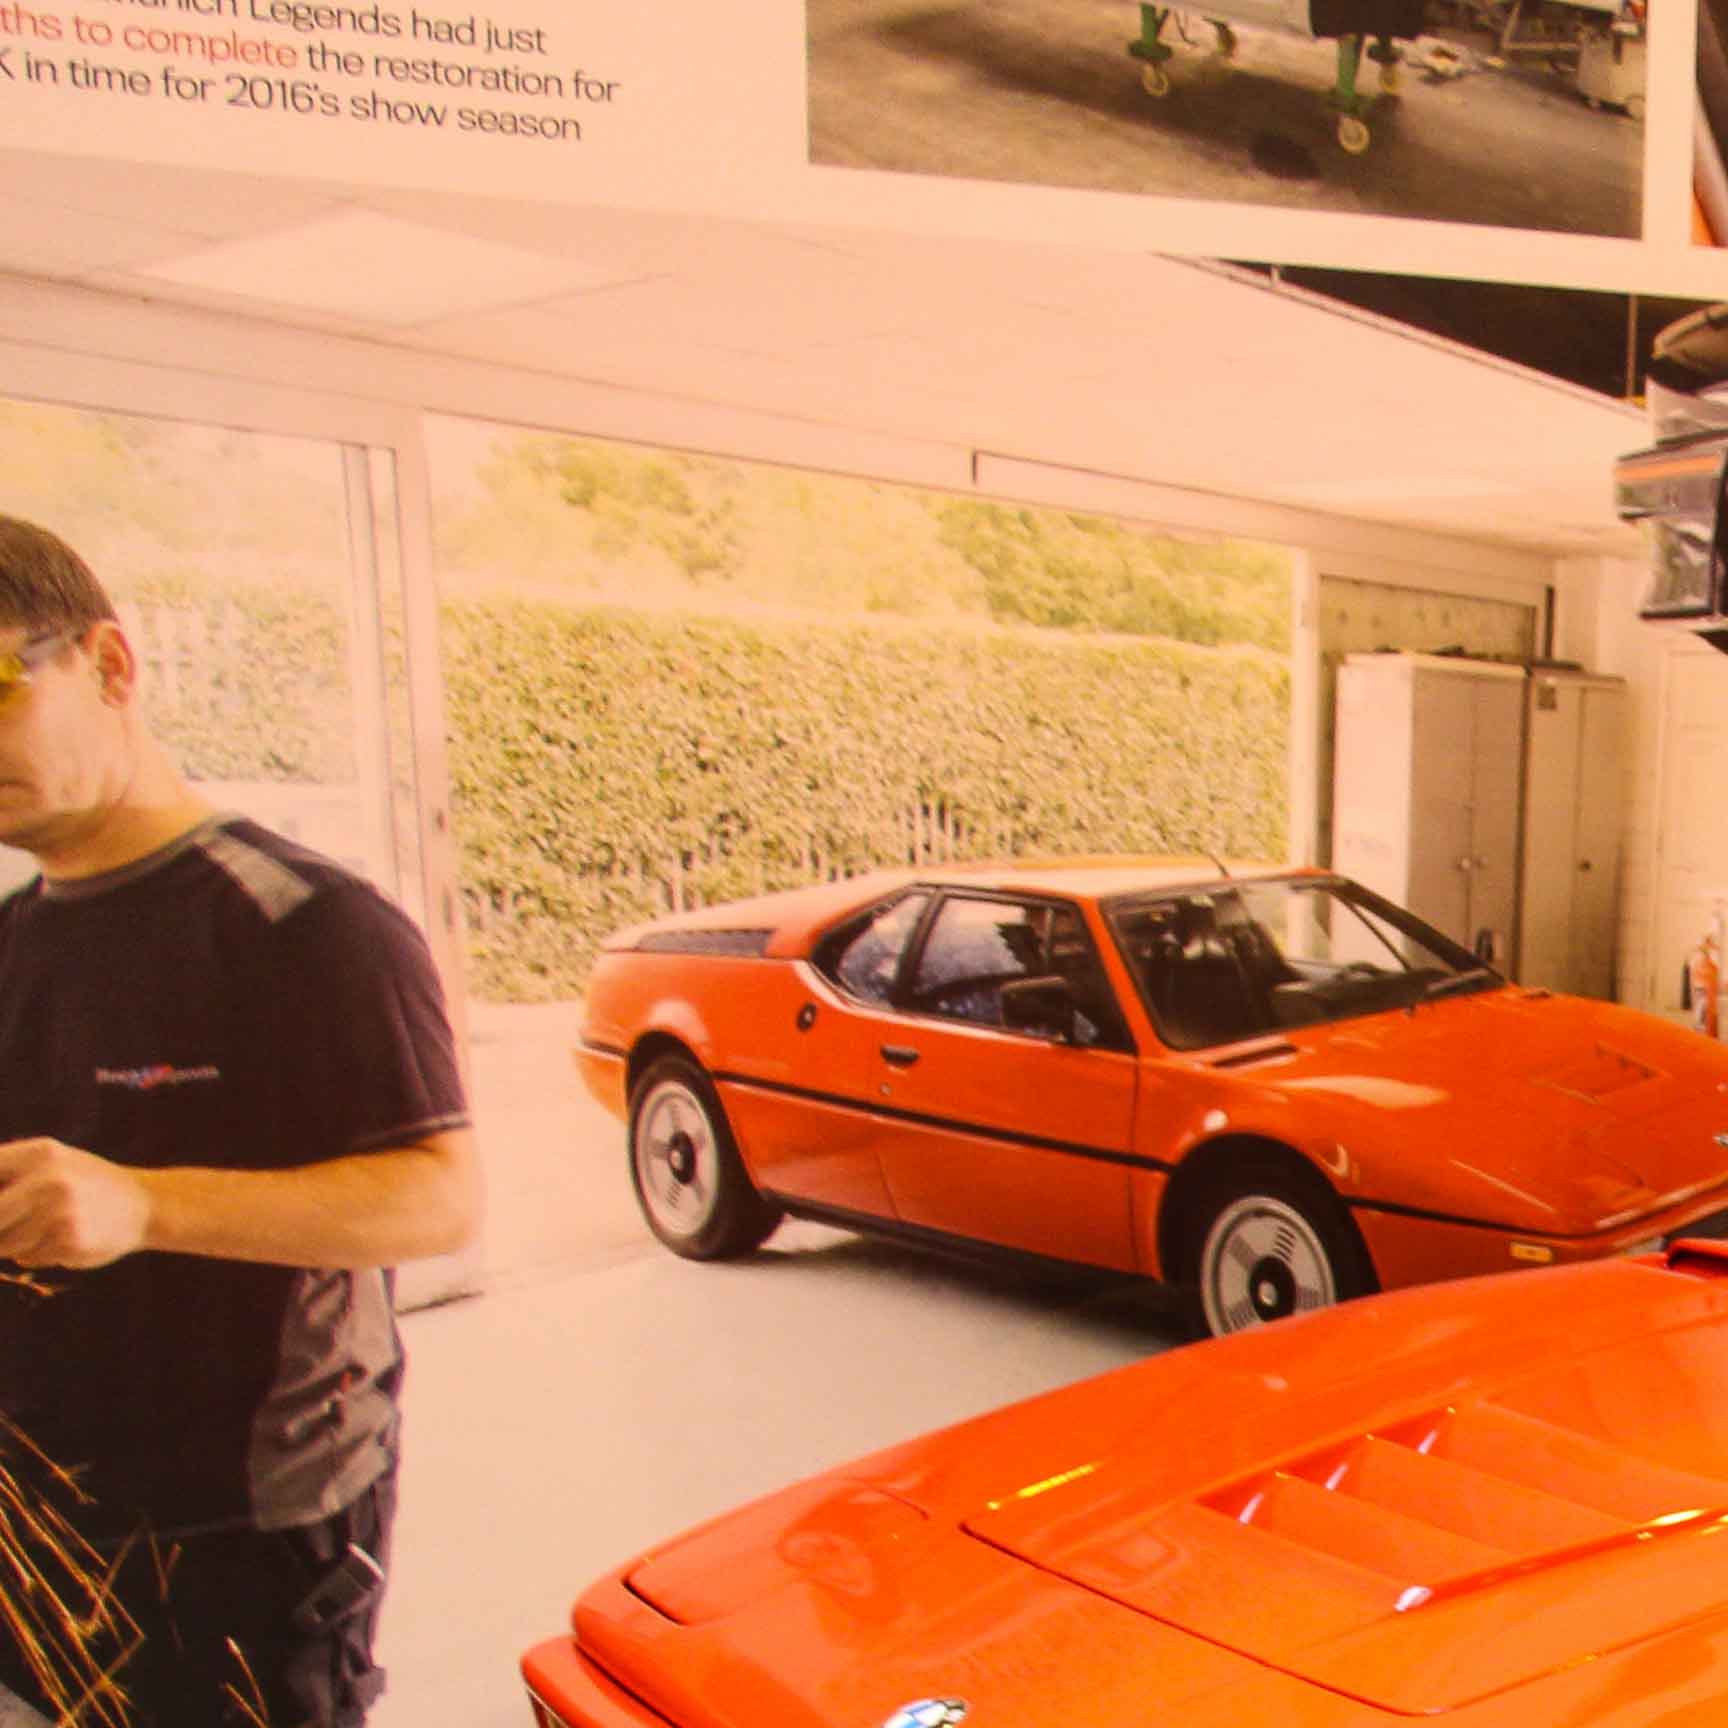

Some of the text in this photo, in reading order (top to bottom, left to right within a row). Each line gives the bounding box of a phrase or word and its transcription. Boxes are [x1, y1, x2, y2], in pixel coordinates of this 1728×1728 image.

[73, 14, 114, 46] to
[123, 27, 299, 69] complete
[308, 40, 365, 76] the
[374, 53, 563, 98] restoration
[573, 69, 622, 103] for
[250, 0, 402, 38] Legends
[411, 8, 476, 47] had
[483, 18, 548, 55] just
[25, 51, 58, 84] in
[68, 57, 151, 96] time
[161, 65, 216, 103] for
[226, 72, 341, 118] 2016's
[349, 90, 448, 128] show
[457, 105, 582, 141] season
